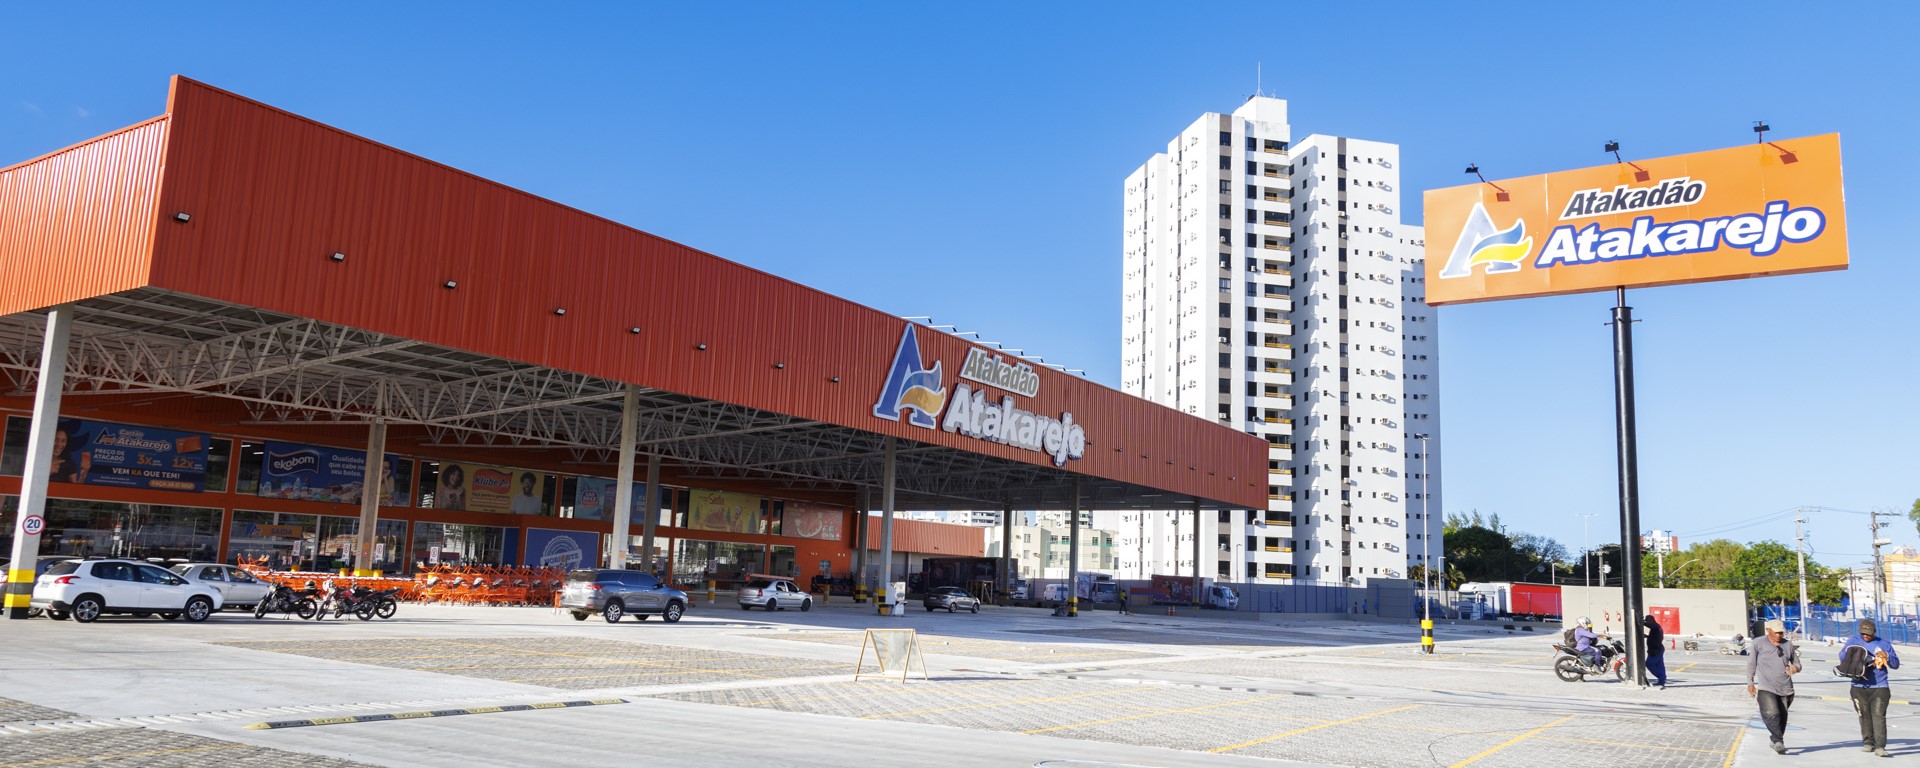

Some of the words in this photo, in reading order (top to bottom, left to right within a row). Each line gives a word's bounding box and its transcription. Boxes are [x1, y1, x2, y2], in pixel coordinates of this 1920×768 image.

[1565, 179, 1704, 219] Atakadão
[1535, 202, 1825, 268] Atakarejo
[962, 348, 1038, 396] Atakadão
[943, 384, 1085, 466] Atakarejo
[116, 437, 171, 451] Atakarejo
[93, 454, 125, 462] ATACADO
[273, 456, 315, 470] ekobom
[331, 454, 365, 464] Qualidade
[112, 467, 130, 475] VEM
[143, 470, 160, 478] QUE
[161, 471, 181, 480] TEM!
[26, 518, 41, 529] 20
